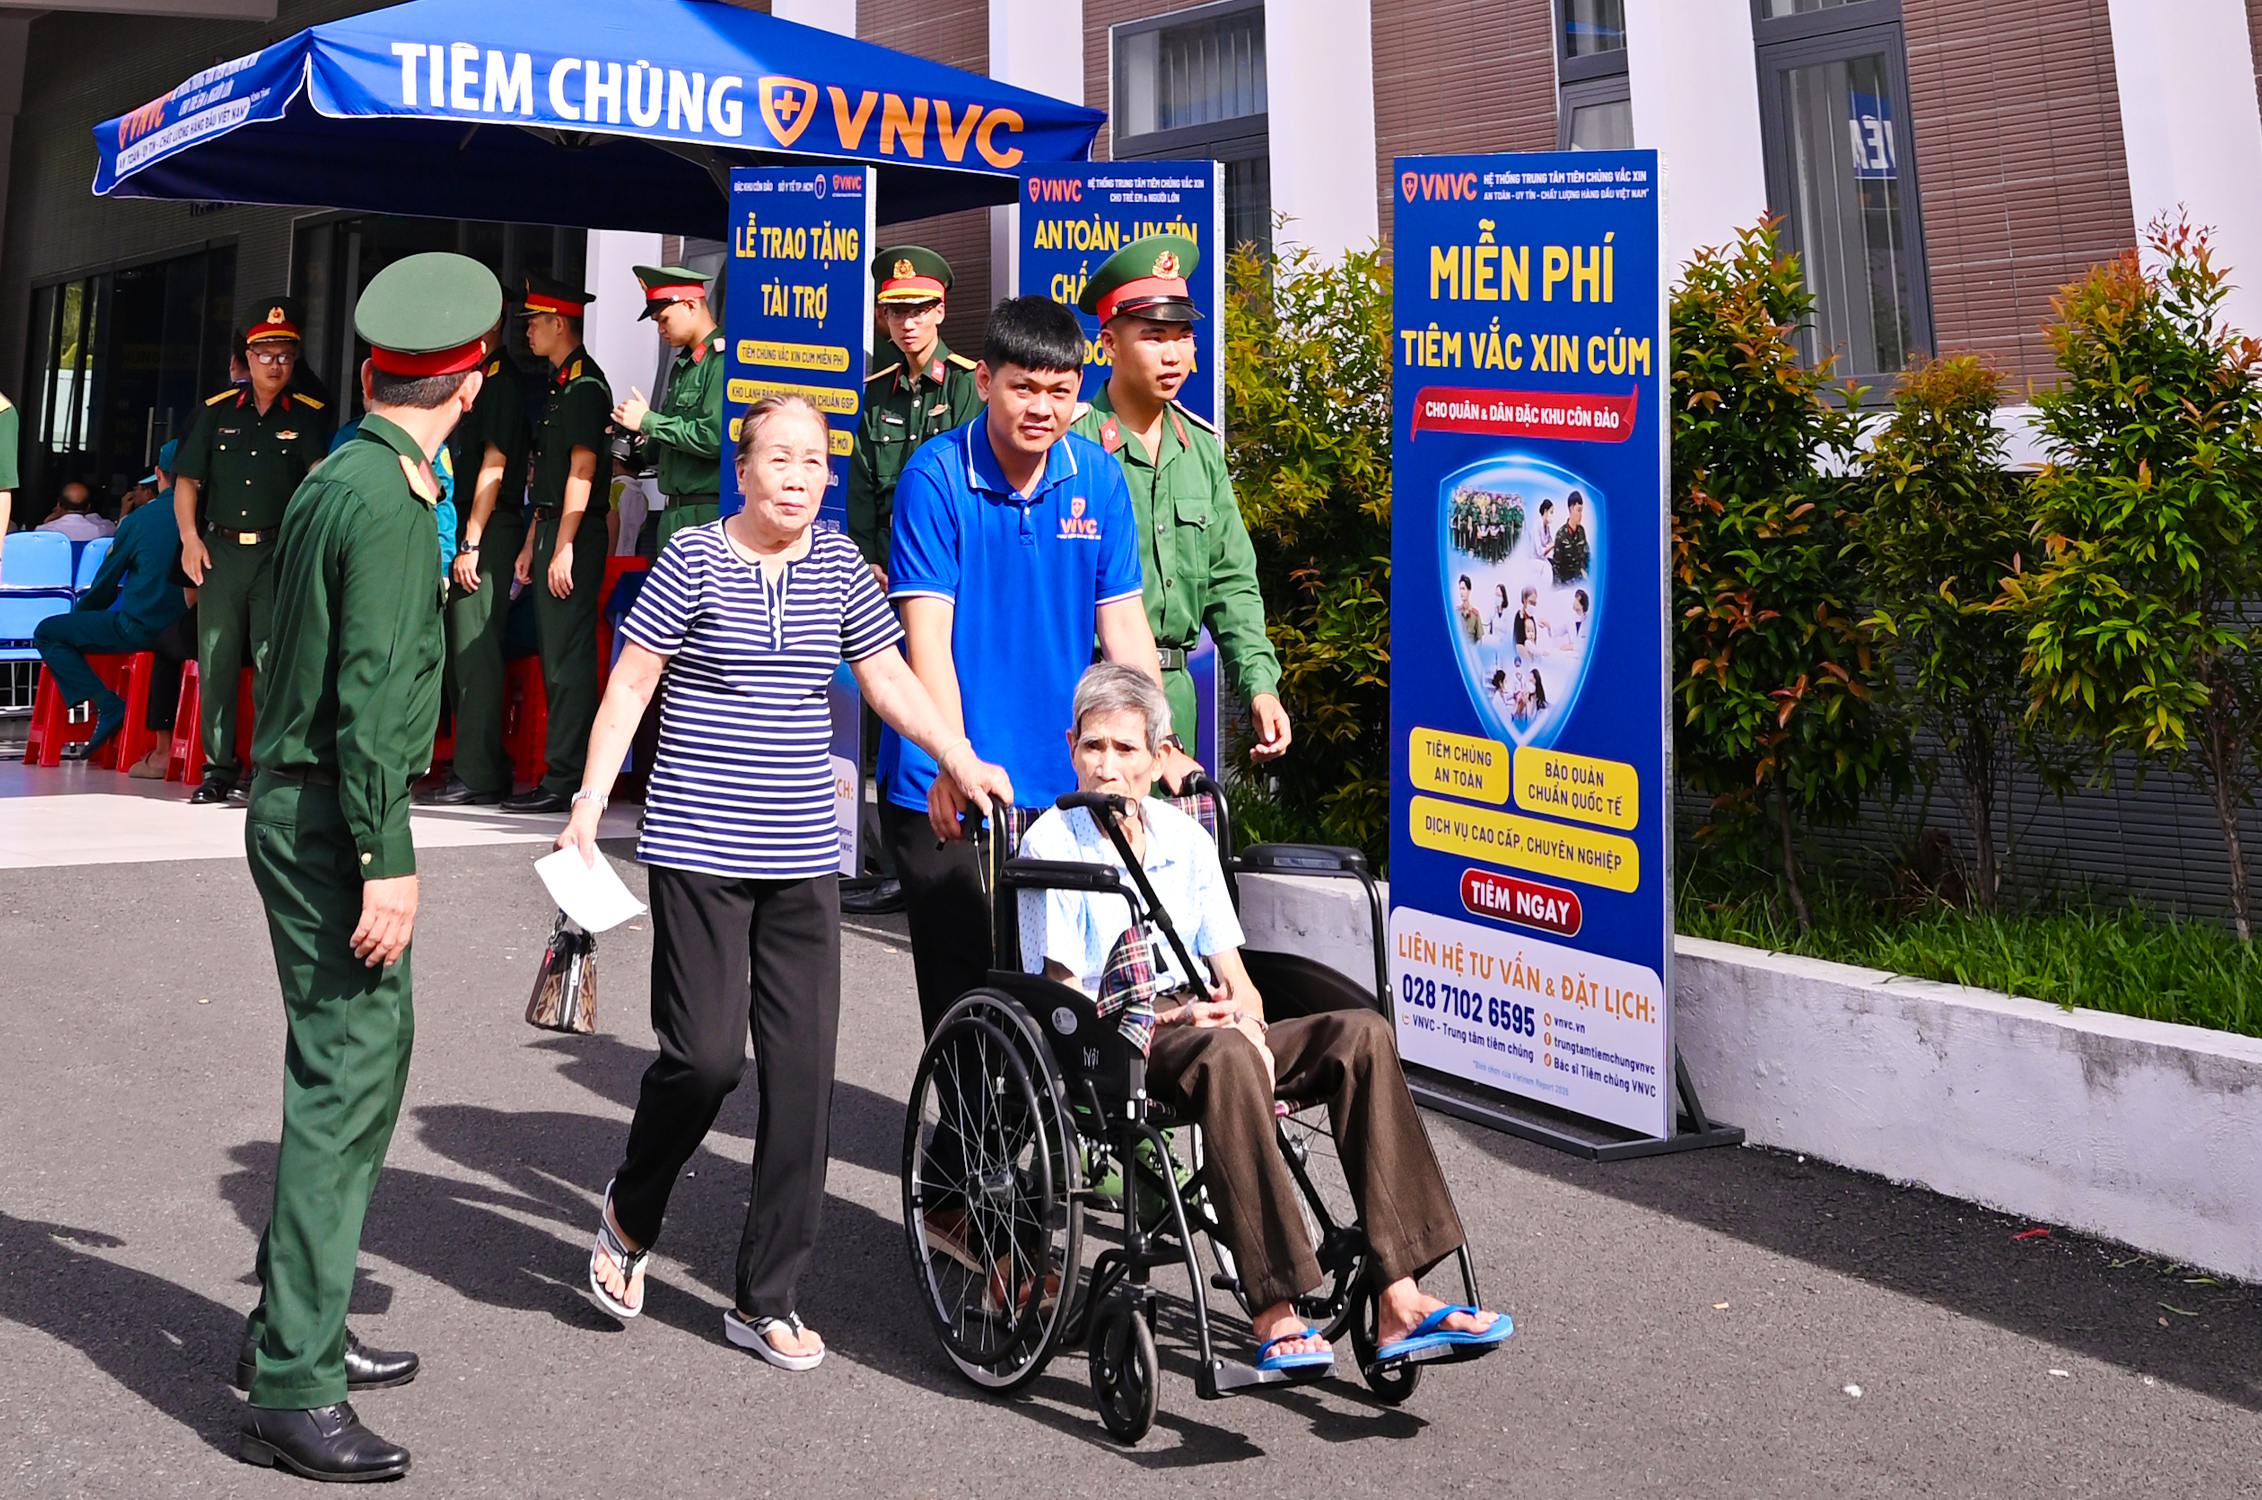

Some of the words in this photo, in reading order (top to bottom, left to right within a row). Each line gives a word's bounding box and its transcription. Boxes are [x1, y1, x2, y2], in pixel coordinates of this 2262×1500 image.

[391, 41, 533, 115] TIÊM
[549, 58, 743, 137] CHỦNG
[827, 86, 1025, 168] VNVC
[840, 175, 862, 190] VNVC
[1042, 178, 1082, 202] VNVC
[1421, 172, 1478, 201] VNVC
[1483, 192, 1493, 200] AN
[1494, 189, 1511, 200] TOÀN
[1515, 191, 1524, 200] UY
[1525, 189, 1536, 200] TÍN
[1540, 188, 1558, 199] CHẤT
[1581, 188, 1600, 199] HÀNG
[1615, 187, 1630, 200] VIỆT
[1484, 172, 1494, 187] HỆ
[1495, 170, 1520, 185] THỐNG
[1521, 173, 1547, 184] TRUNG
[1548, 170, 1565, 183] TÂM
[1566, 169, 1585, 183] TIÊM
[1586, 168, 1613, 183] CHỦNG
[1615, 166, 1631, 182] VẮC
[1632, 170, 1647, 182] XIN
[736, 211, 757, 258] LỄ
[760, 226, 806, 260] TRAO
[810, 220, 859, 270] TẶNG
[1034, 219, 1063, 250] AN
[1065, 212, 1119, 251] TOÀN
[1430, 218, 1530, 301] MIỄN
[1543, 231, 1615, 303] PHÍ
[1051, 260, 1092, 304] CHẤ
[761, 276, 788, 317] TÀI
[792, 283, 828, 329] TRỢ
[1400, 322, 1462, 368] TIÊM
[1469, 315, 1523, 371] VẮC
[1530, 333, 1580, 373] XIN
[1587, 327, 1651, 376] CÚM
[1425, 401, 1448, 418] CHO
[1448, 400, 1480, 421] QUÂN
[1480, 408, 1488, 420] &
[1490, 402, 1514, 422] DÂN
[1515, 403, 1540, 428] ĐẶC
[1541, 408, 1565, 426] KHU
[1566, 406, 1592, 428] CÔN
[1594, 406, 1620, 429] ĐẢO
[1425, 739, 1451, 760] TIÊM
[1454, 744, 1492, 767] CHỦNG
[1545, 758, 1568, 782] BẢO
[1571, 764, 1604, 788] QUẢN
[1434, 766, 1450, 784] AN
[1453, 768, 1483, 790] TOÀN
[1528, 781, 1568, 806] CHUẨN
[1572, 790, 1604, 814] QUỐC
[1608, 794, 1623, 817] TẾ
[1425, 814, 1451, 836] DỊCH
[1454, 820, 1468, 842] VỤ
[1471, 824, 1494, 844] CAO
[1497, 827, 1524, 852] CẤP,
[1526, 836, 1574, 862] CHUYÊN
[1577, 846, 1622, 874] NGHIỆP
[1470, 878, 1511, 912] TIÊM
[1516, 896, 1571, 926] NGAY
[1398, 931, 1436, 966] LIÊN
[1442, 941, 1464, 978] HỆ
[1469, 950, 1494, 980] TƯ
[1500, 950, 1540, 994] VẤN
[1545, 977, 1556, 998] &
[1561, 971, 1599, 1011] ĐẶT
[1604, 986, 1656, 1025] LỊCH:
[1402, 972, 1436, 1010] 028
[1440, 982, 1484, 1024] 7102
[1488, 996, 1536, 1038] 6595
[1412, 1014, 1435, 1032] VNVC
[1442, 1022, 1467, 1044] Trung
[1468, 1031, 1485, 1046] tâm
[1486, 1036, 1506, 1052] tiêm
[1508, 1042, 1534, 1064] chủng
[1554, 1017, 1586, 1034] vnvc.vn
[1554, 1036, 1656, 1076] trungtamtiemchungvnvc
[1554, 1056, 1570, 1072] Bác
[1571, 1062, 1580, 1076] sĩ
[1580, 1064, 1602, 1082] Tiêm
[1604, 1072, 1630, 1093] chủng
[1632, 1079, 1656, 1098] VNVC
